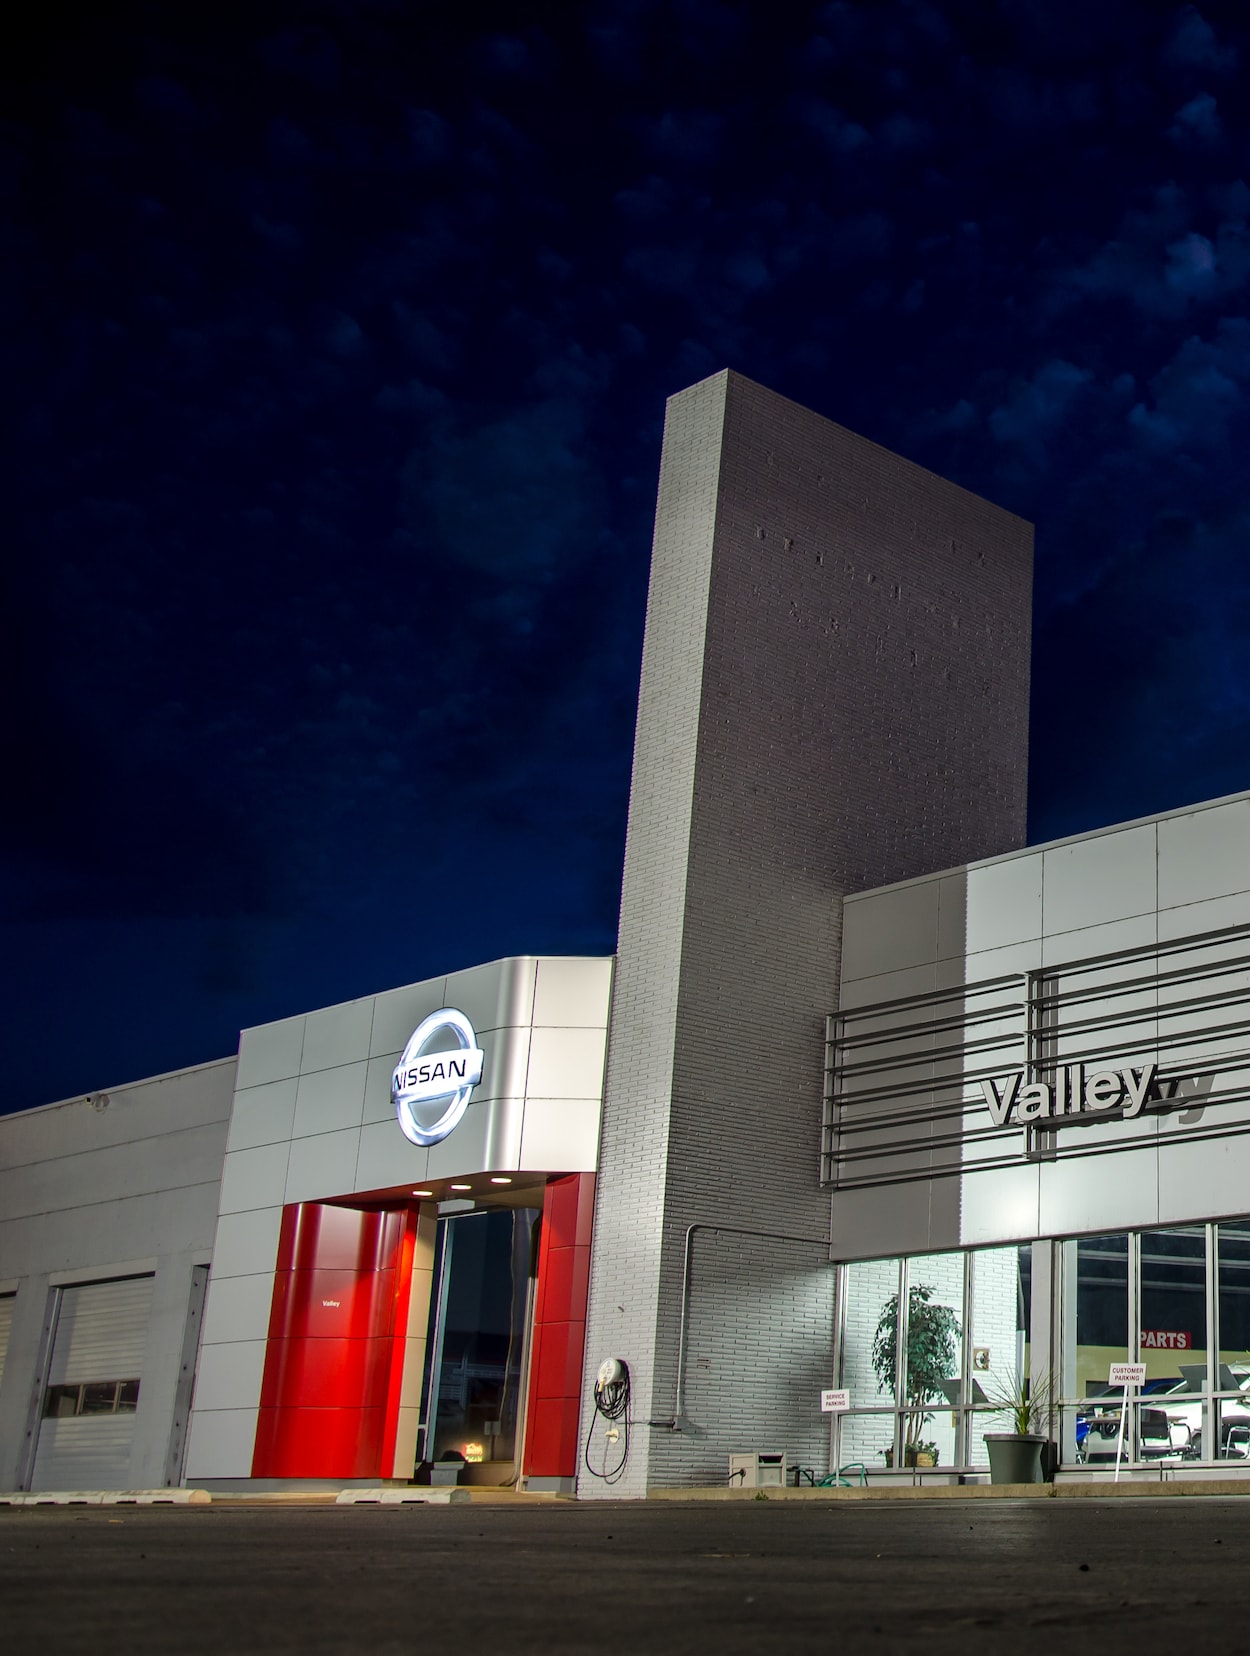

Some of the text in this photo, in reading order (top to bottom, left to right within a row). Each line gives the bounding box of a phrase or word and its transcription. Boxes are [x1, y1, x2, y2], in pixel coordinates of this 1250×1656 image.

[395, 1059, 467, 1090] NISSAN
[980, 1064, 1158, 1125] Valley
[322, 1300, 341, 1308] Valley
[1140, 1331, 1187, 1348] PARTS
